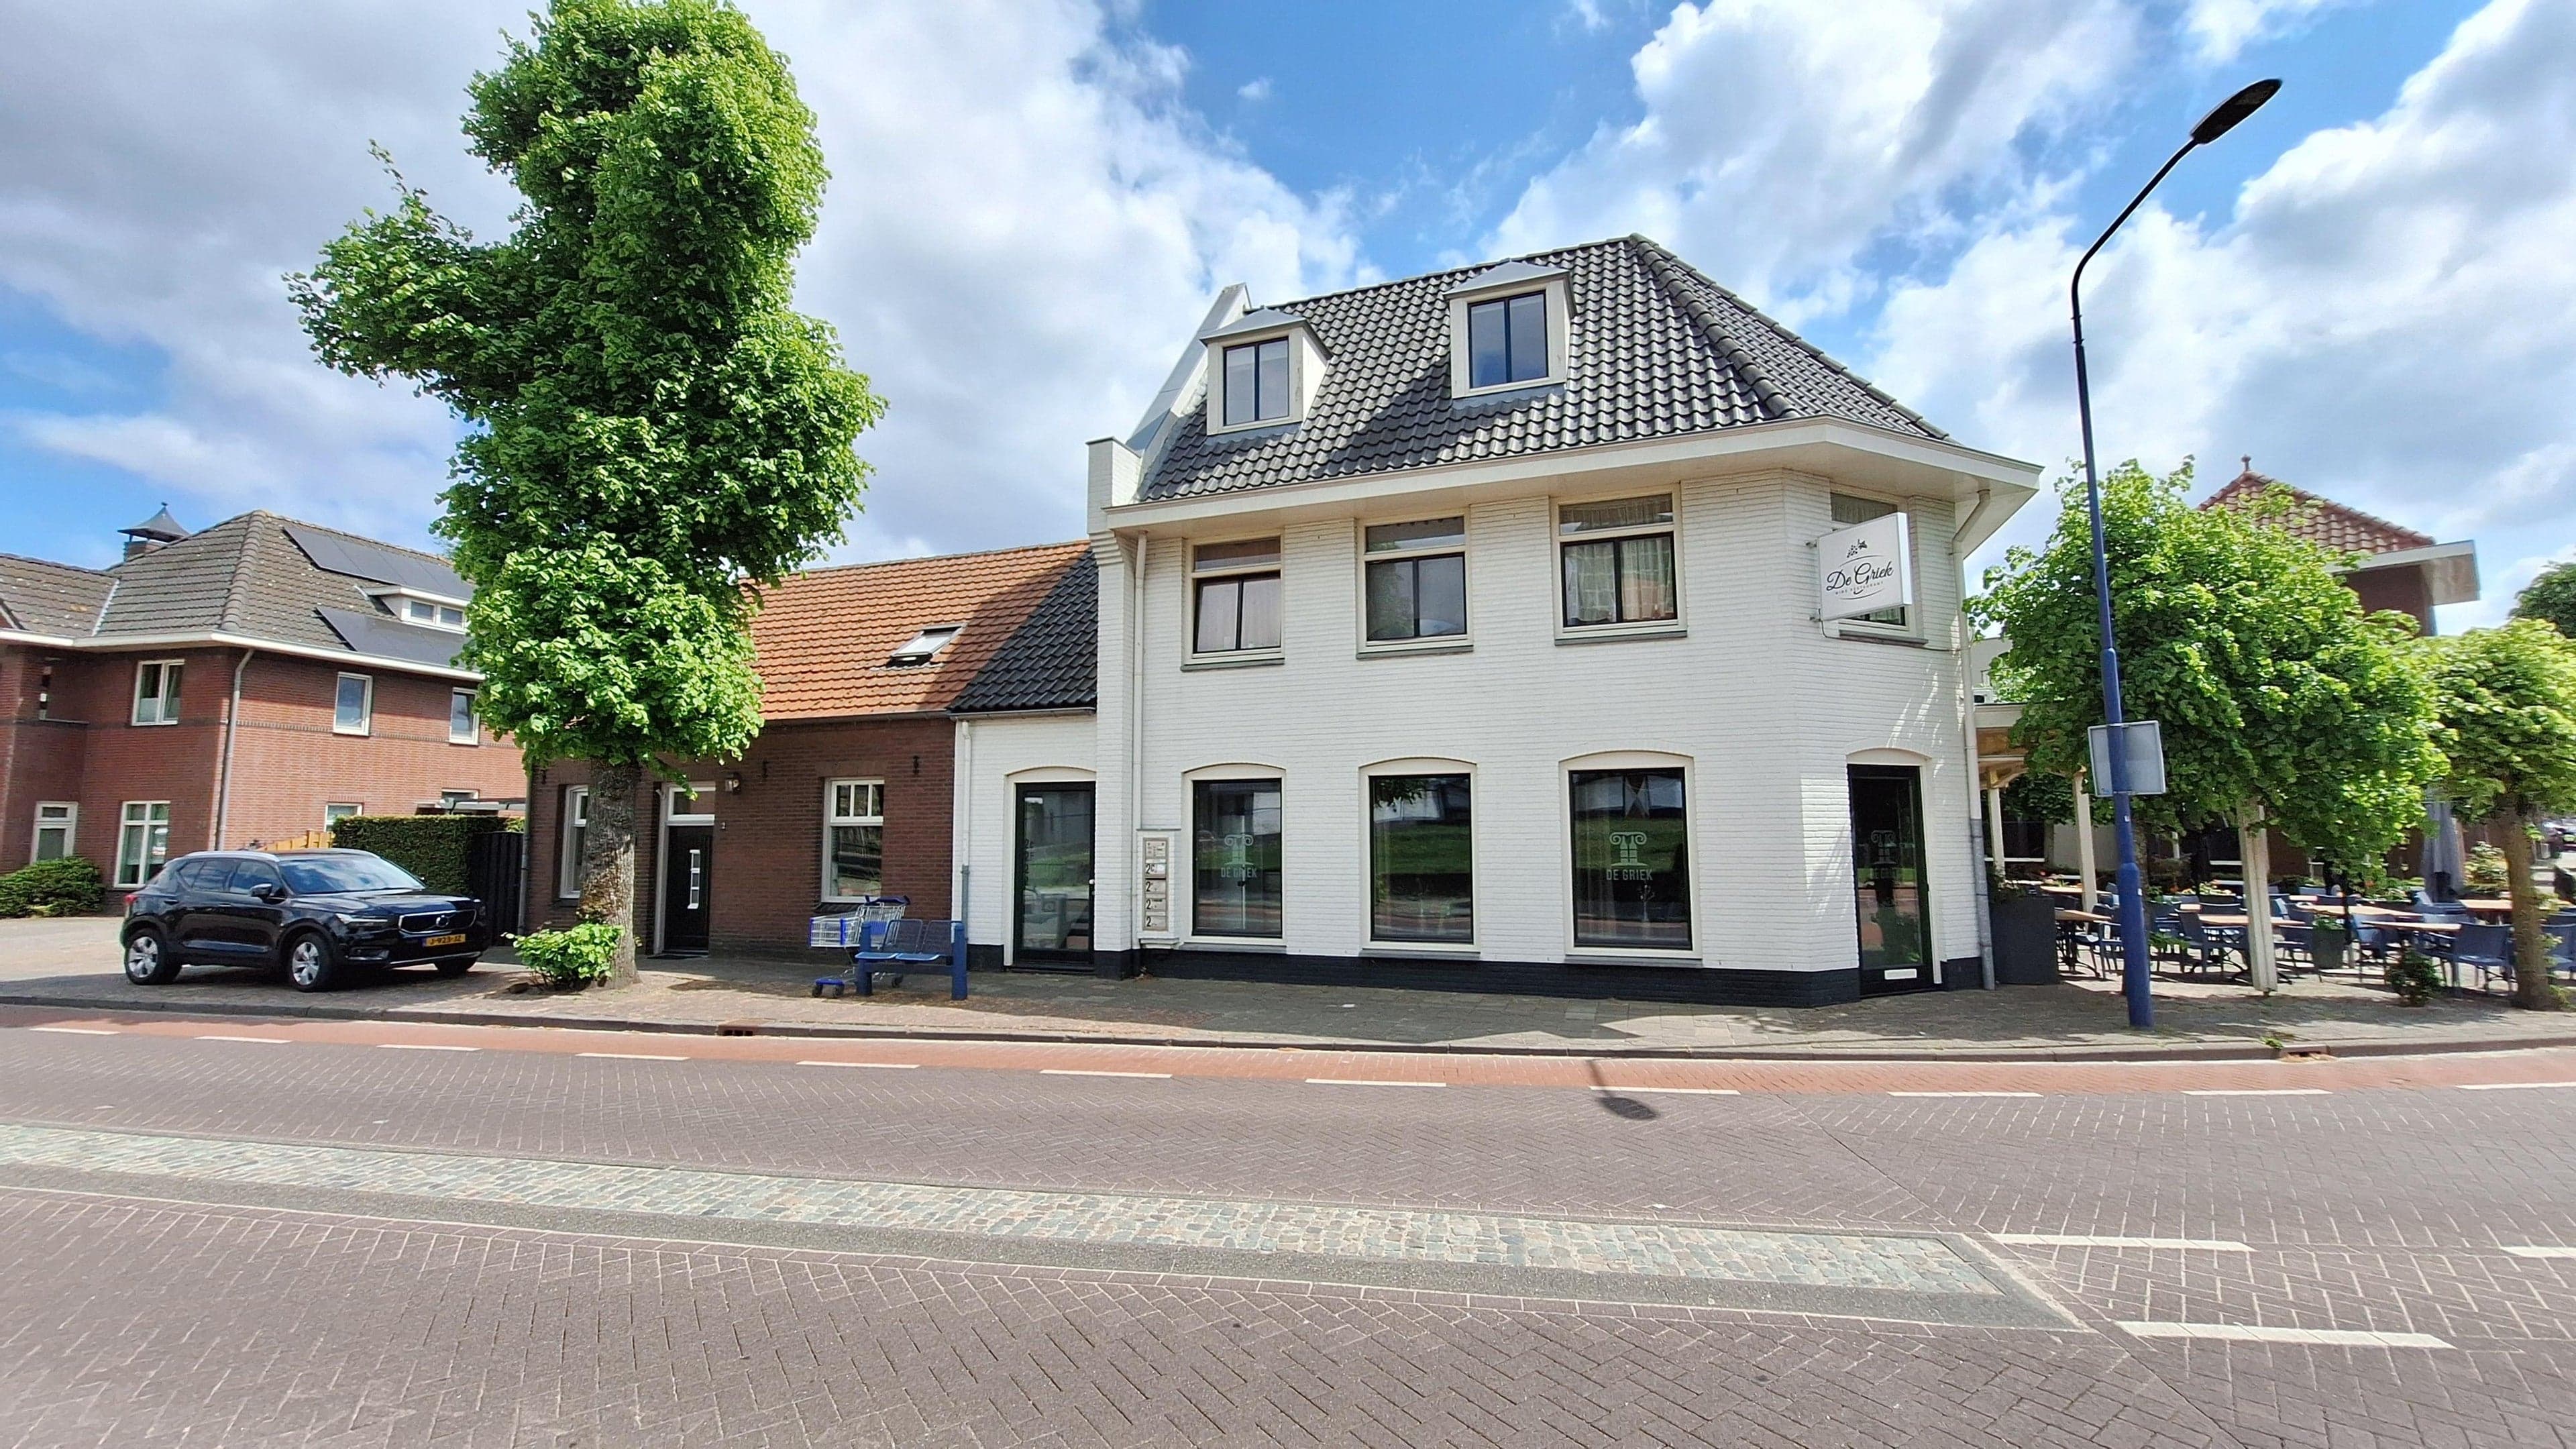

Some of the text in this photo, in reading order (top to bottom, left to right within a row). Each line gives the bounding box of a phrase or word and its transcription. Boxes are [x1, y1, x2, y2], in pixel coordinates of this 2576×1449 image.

[1826, 561, 1894, 594] De Griek
[1221, 867, 1231, 877] DE
[1606, 869, 1653, 880] DE GRIEK
